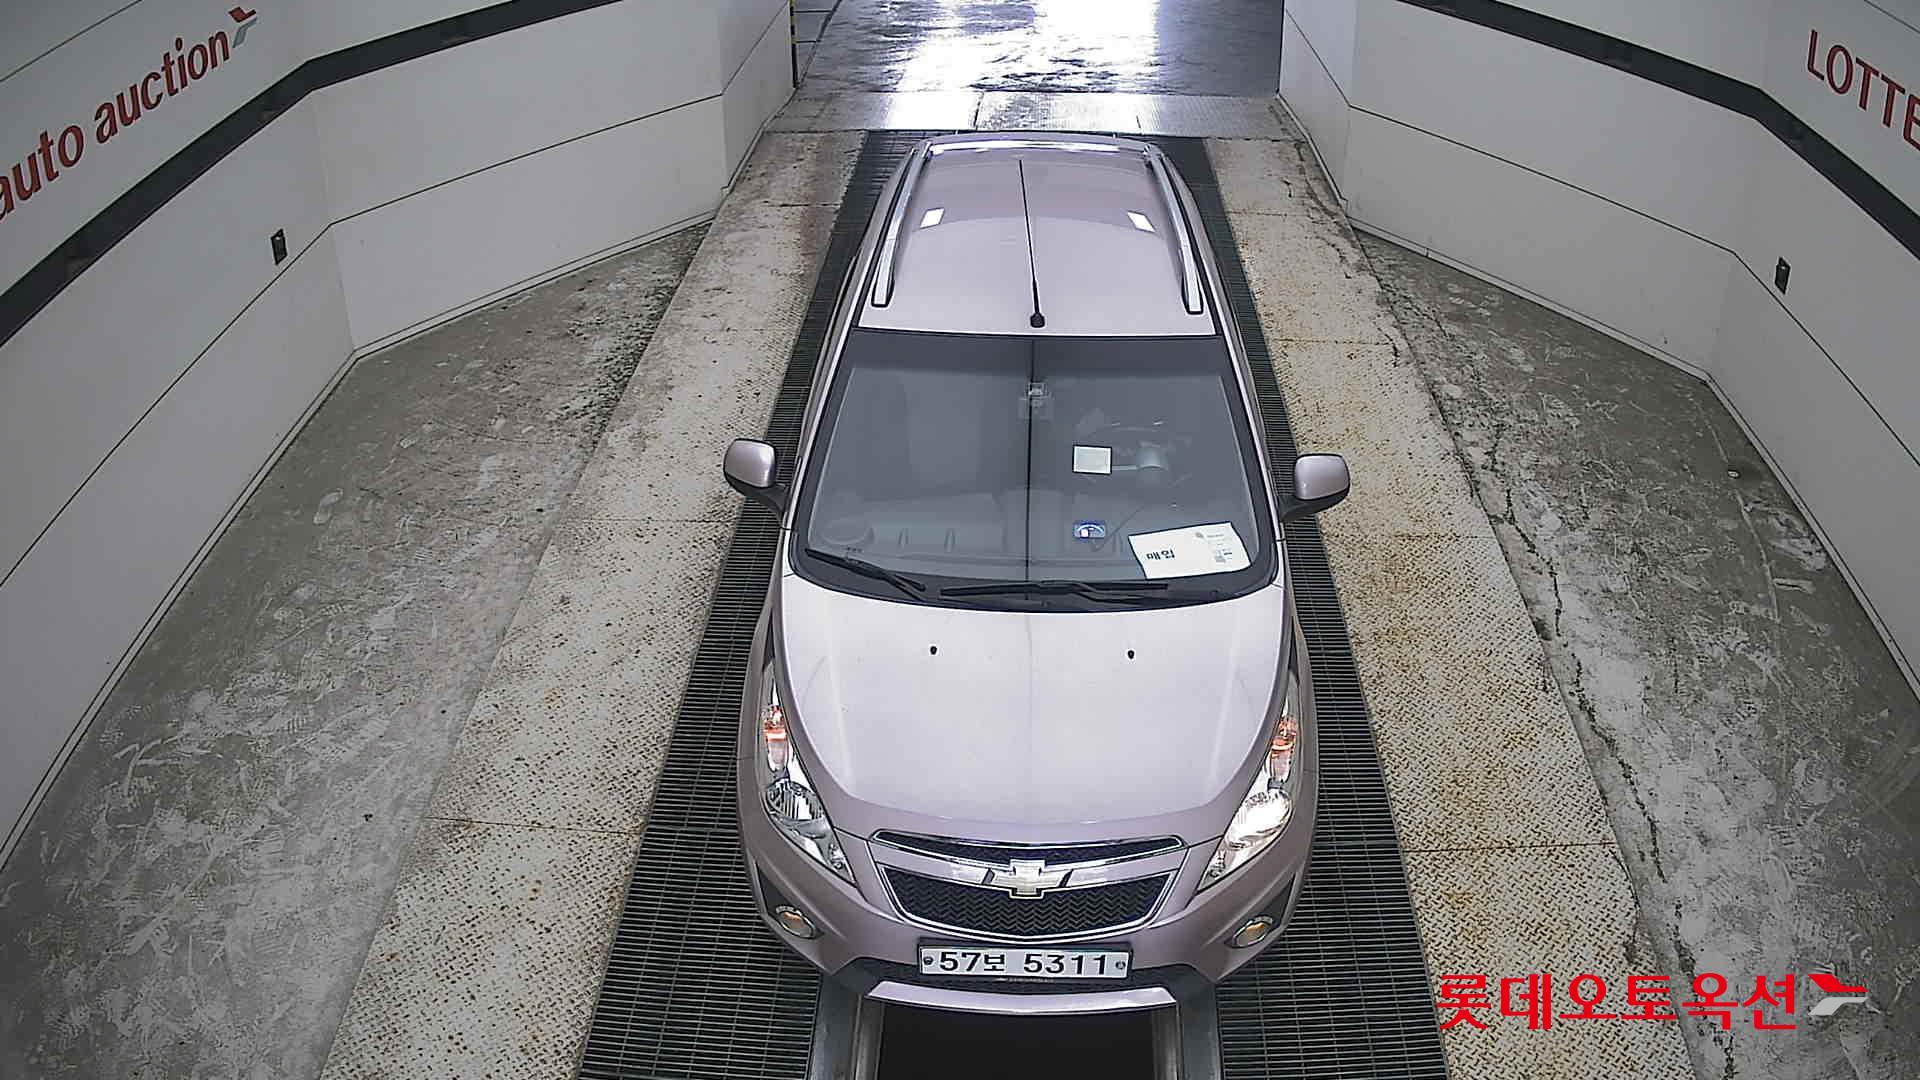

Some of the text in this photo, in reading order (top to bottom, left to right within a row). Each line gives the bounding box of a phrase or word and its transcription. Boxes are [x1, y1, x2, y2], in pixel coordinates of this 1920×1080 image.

[94, 31, 230, 144] auction
[1807, 29, 1920, 151] LOTTE
[939, 951, 1107, 975] 57보 5311
